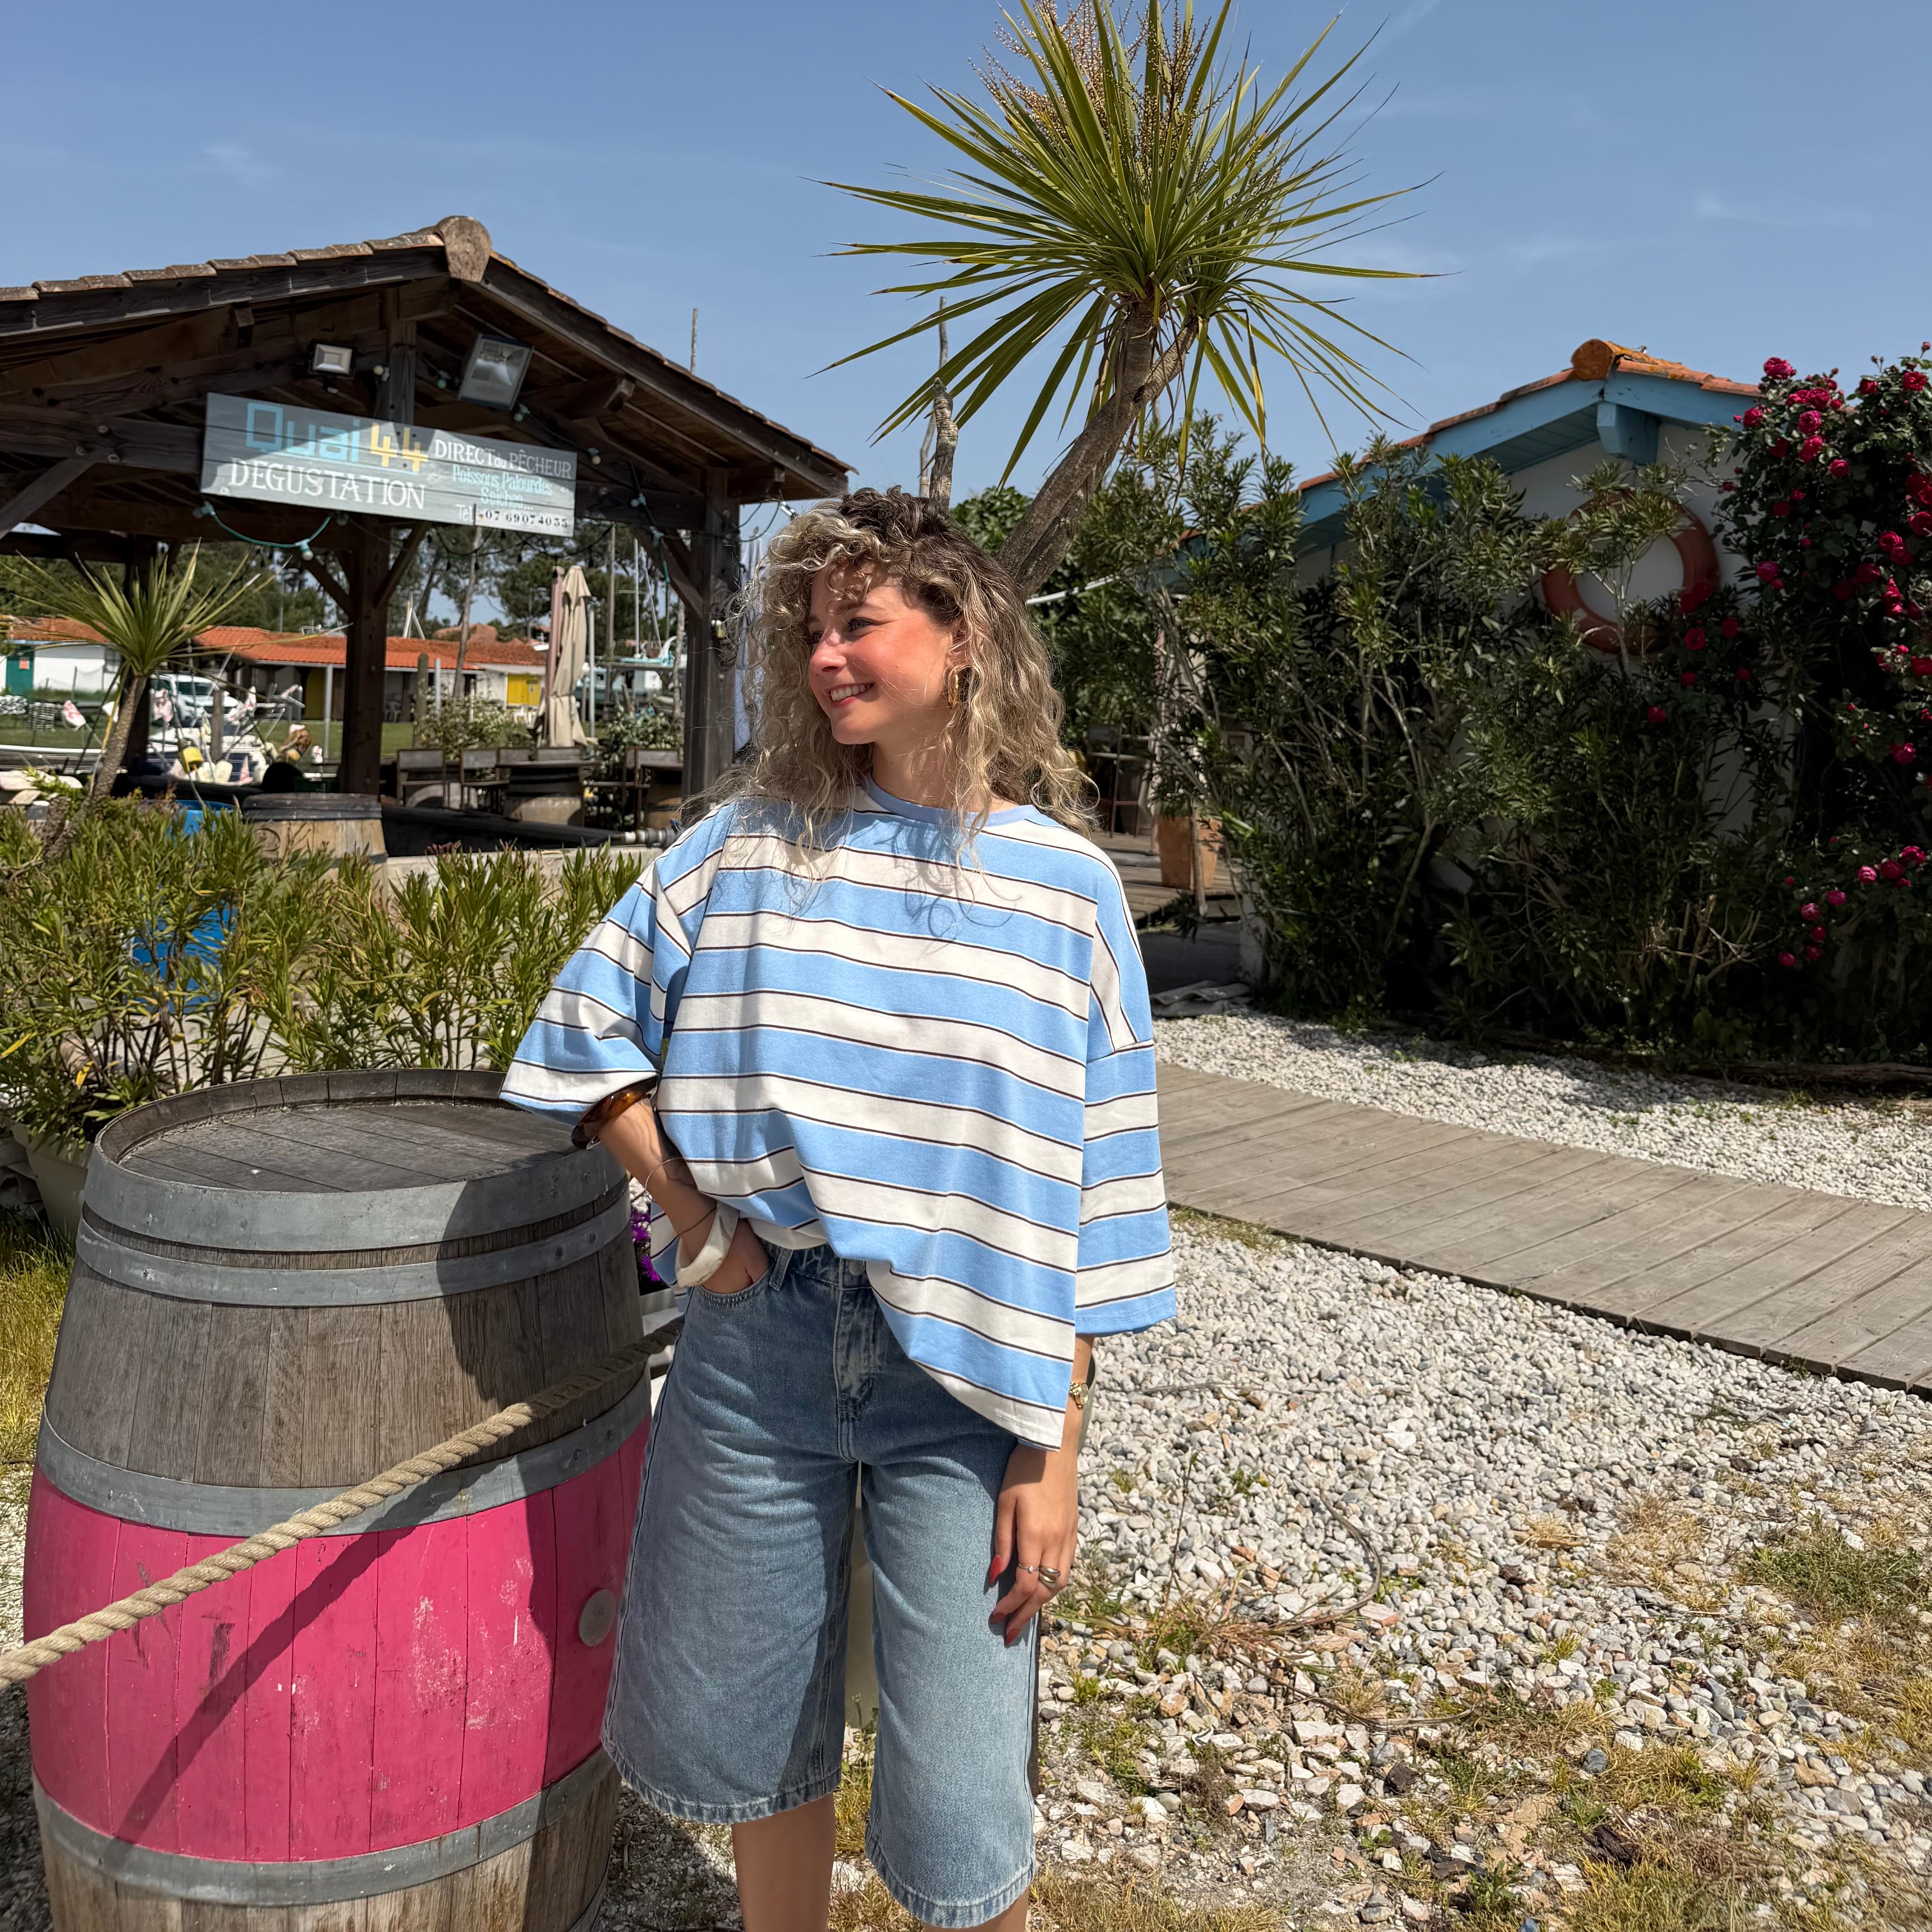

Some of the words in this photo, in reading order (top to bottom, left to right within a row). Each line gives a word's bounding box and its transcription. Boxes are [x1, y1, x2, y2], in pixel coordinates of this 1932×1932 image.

[246, 402, 360, 463] Quai
[370, 422, 429, 472] 44
[434, 439, 496, 466] DIRECT
[494, 452, 507, 468] du
[509, 448, 572, 479] PÊCHEUR
[502, 471, 553, 496] Palourdes
